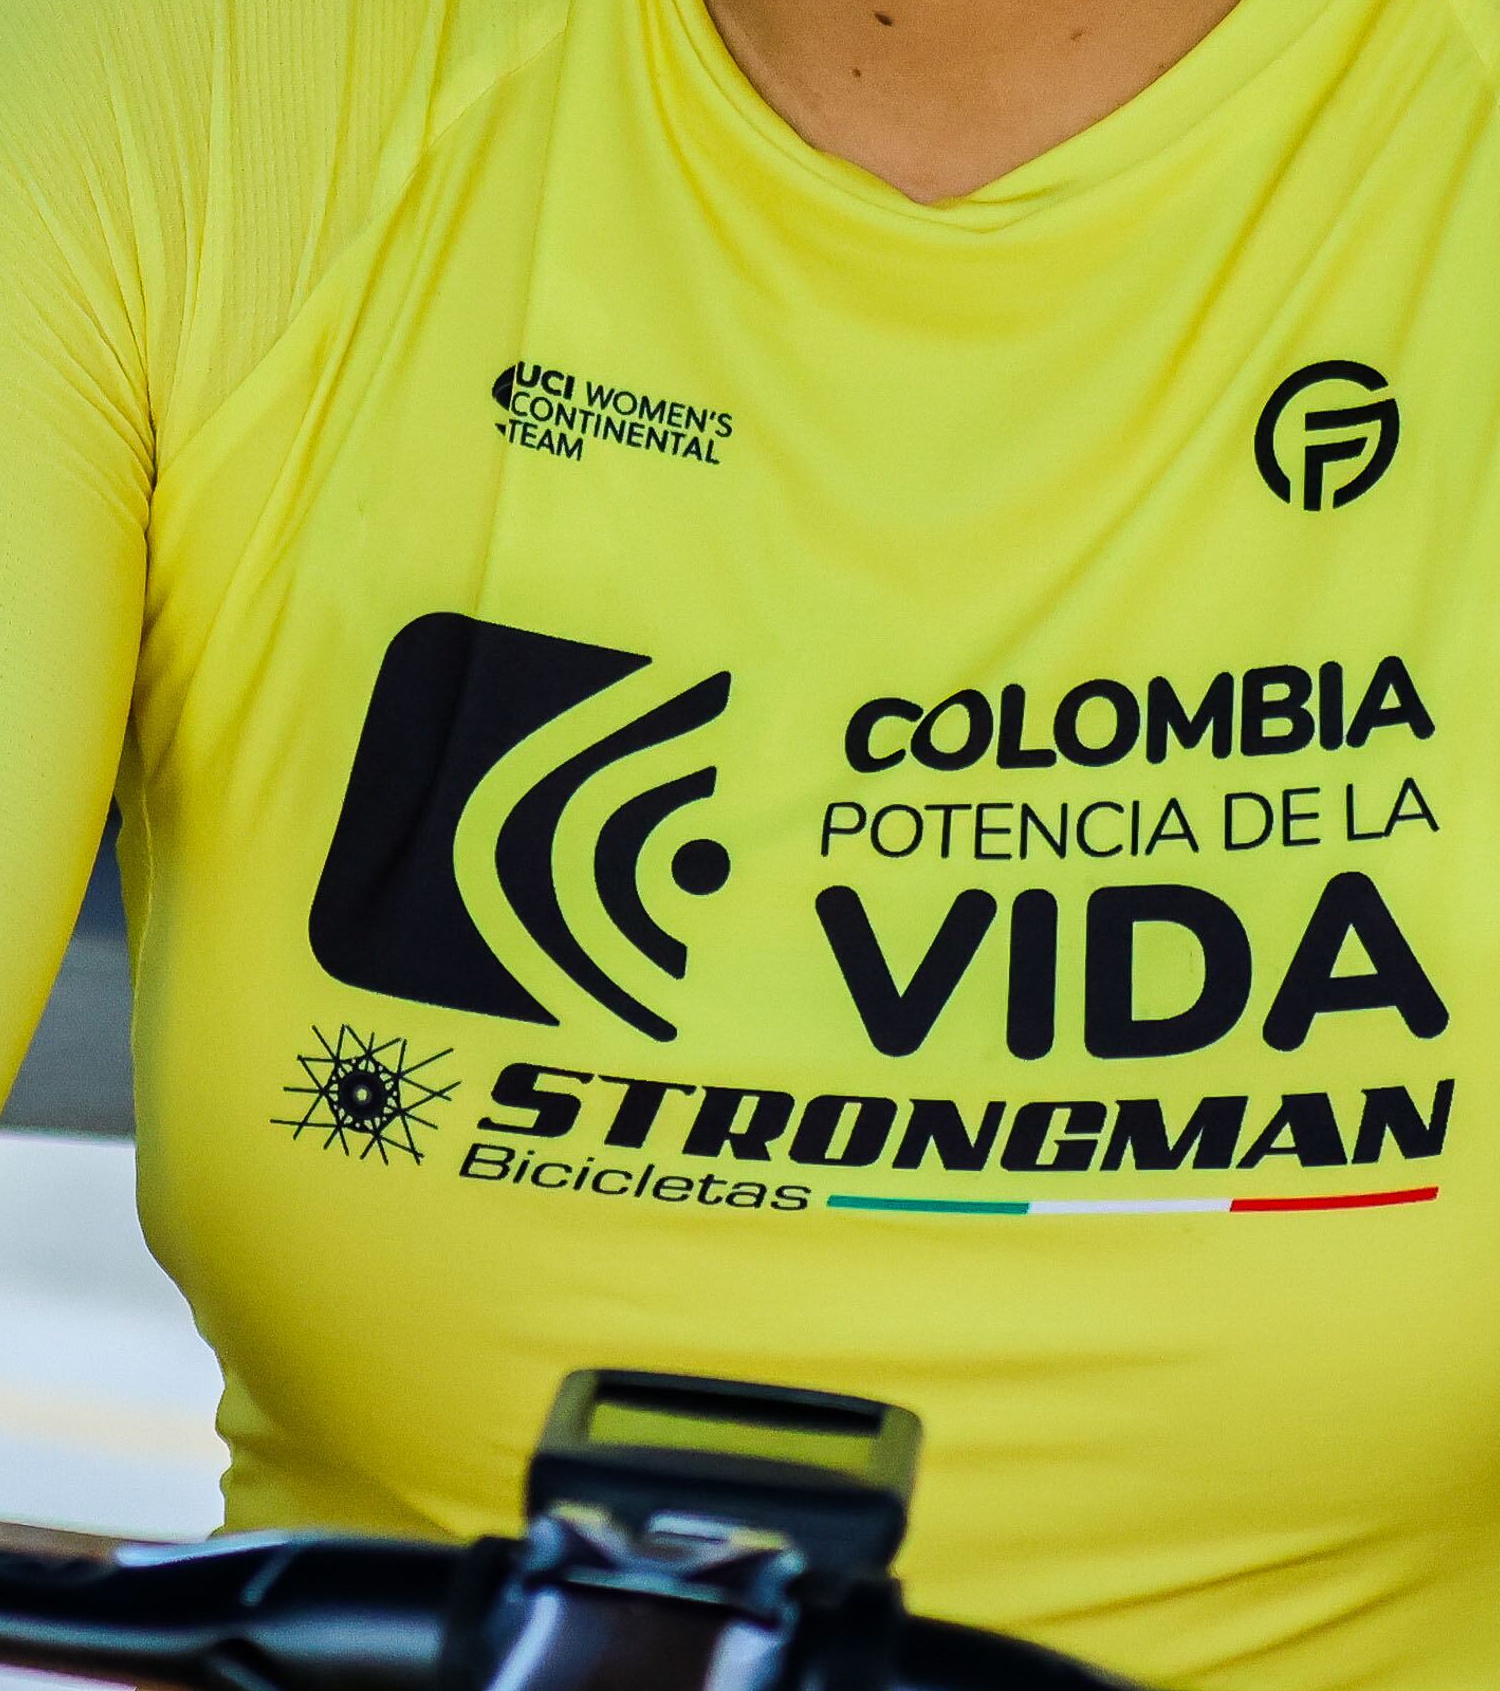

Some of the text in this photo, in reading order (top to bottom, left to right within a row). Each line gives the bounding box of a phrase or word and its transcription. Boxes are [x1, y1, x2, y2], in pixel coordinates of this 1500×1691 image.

[508, 418, 584, 461] TEAM
[510, 391, 720, 465] CONTINENTAL
[516, 360, 734, 438] UCI WOMEN'S
[844, 655, 1436, 774] COLOMBIA
[820, 777, 1440, 861] POTENCIA DE LA
[815, 871, 1450, 1061] VIDA
[476, 1062, 1455, 1172] STRONGMAN
[458, 1142, 812, 1211] Bicicletas
